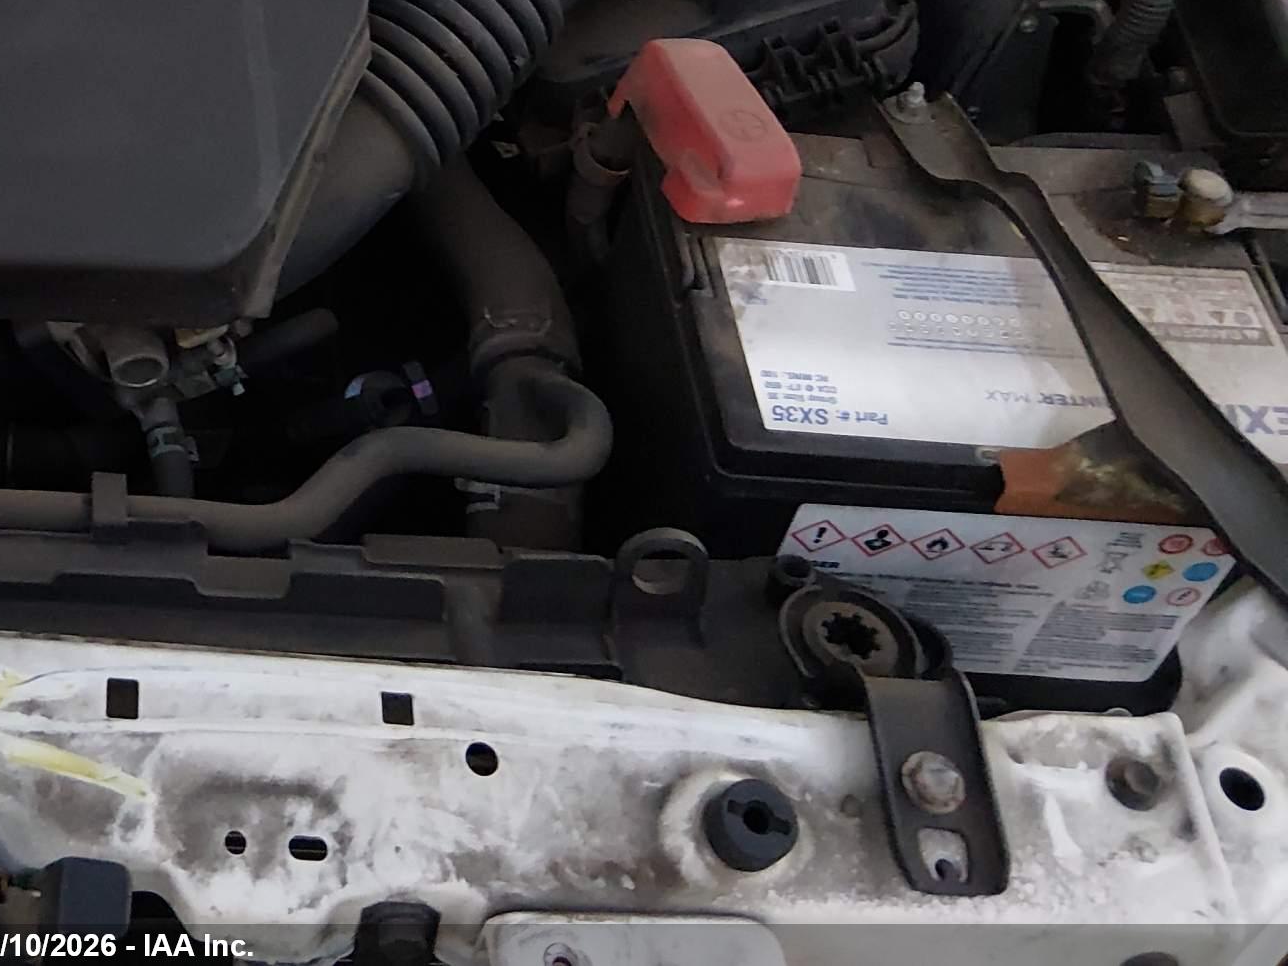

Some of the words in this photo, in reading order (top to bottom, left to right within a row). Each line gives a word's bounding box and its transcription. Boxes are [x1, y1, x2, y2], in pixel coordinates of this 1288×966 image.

[983, 390, 1030, 404] MAX
[771, 405, 829, 425] SX35
[1225, 404, 1288, 436] EXI
